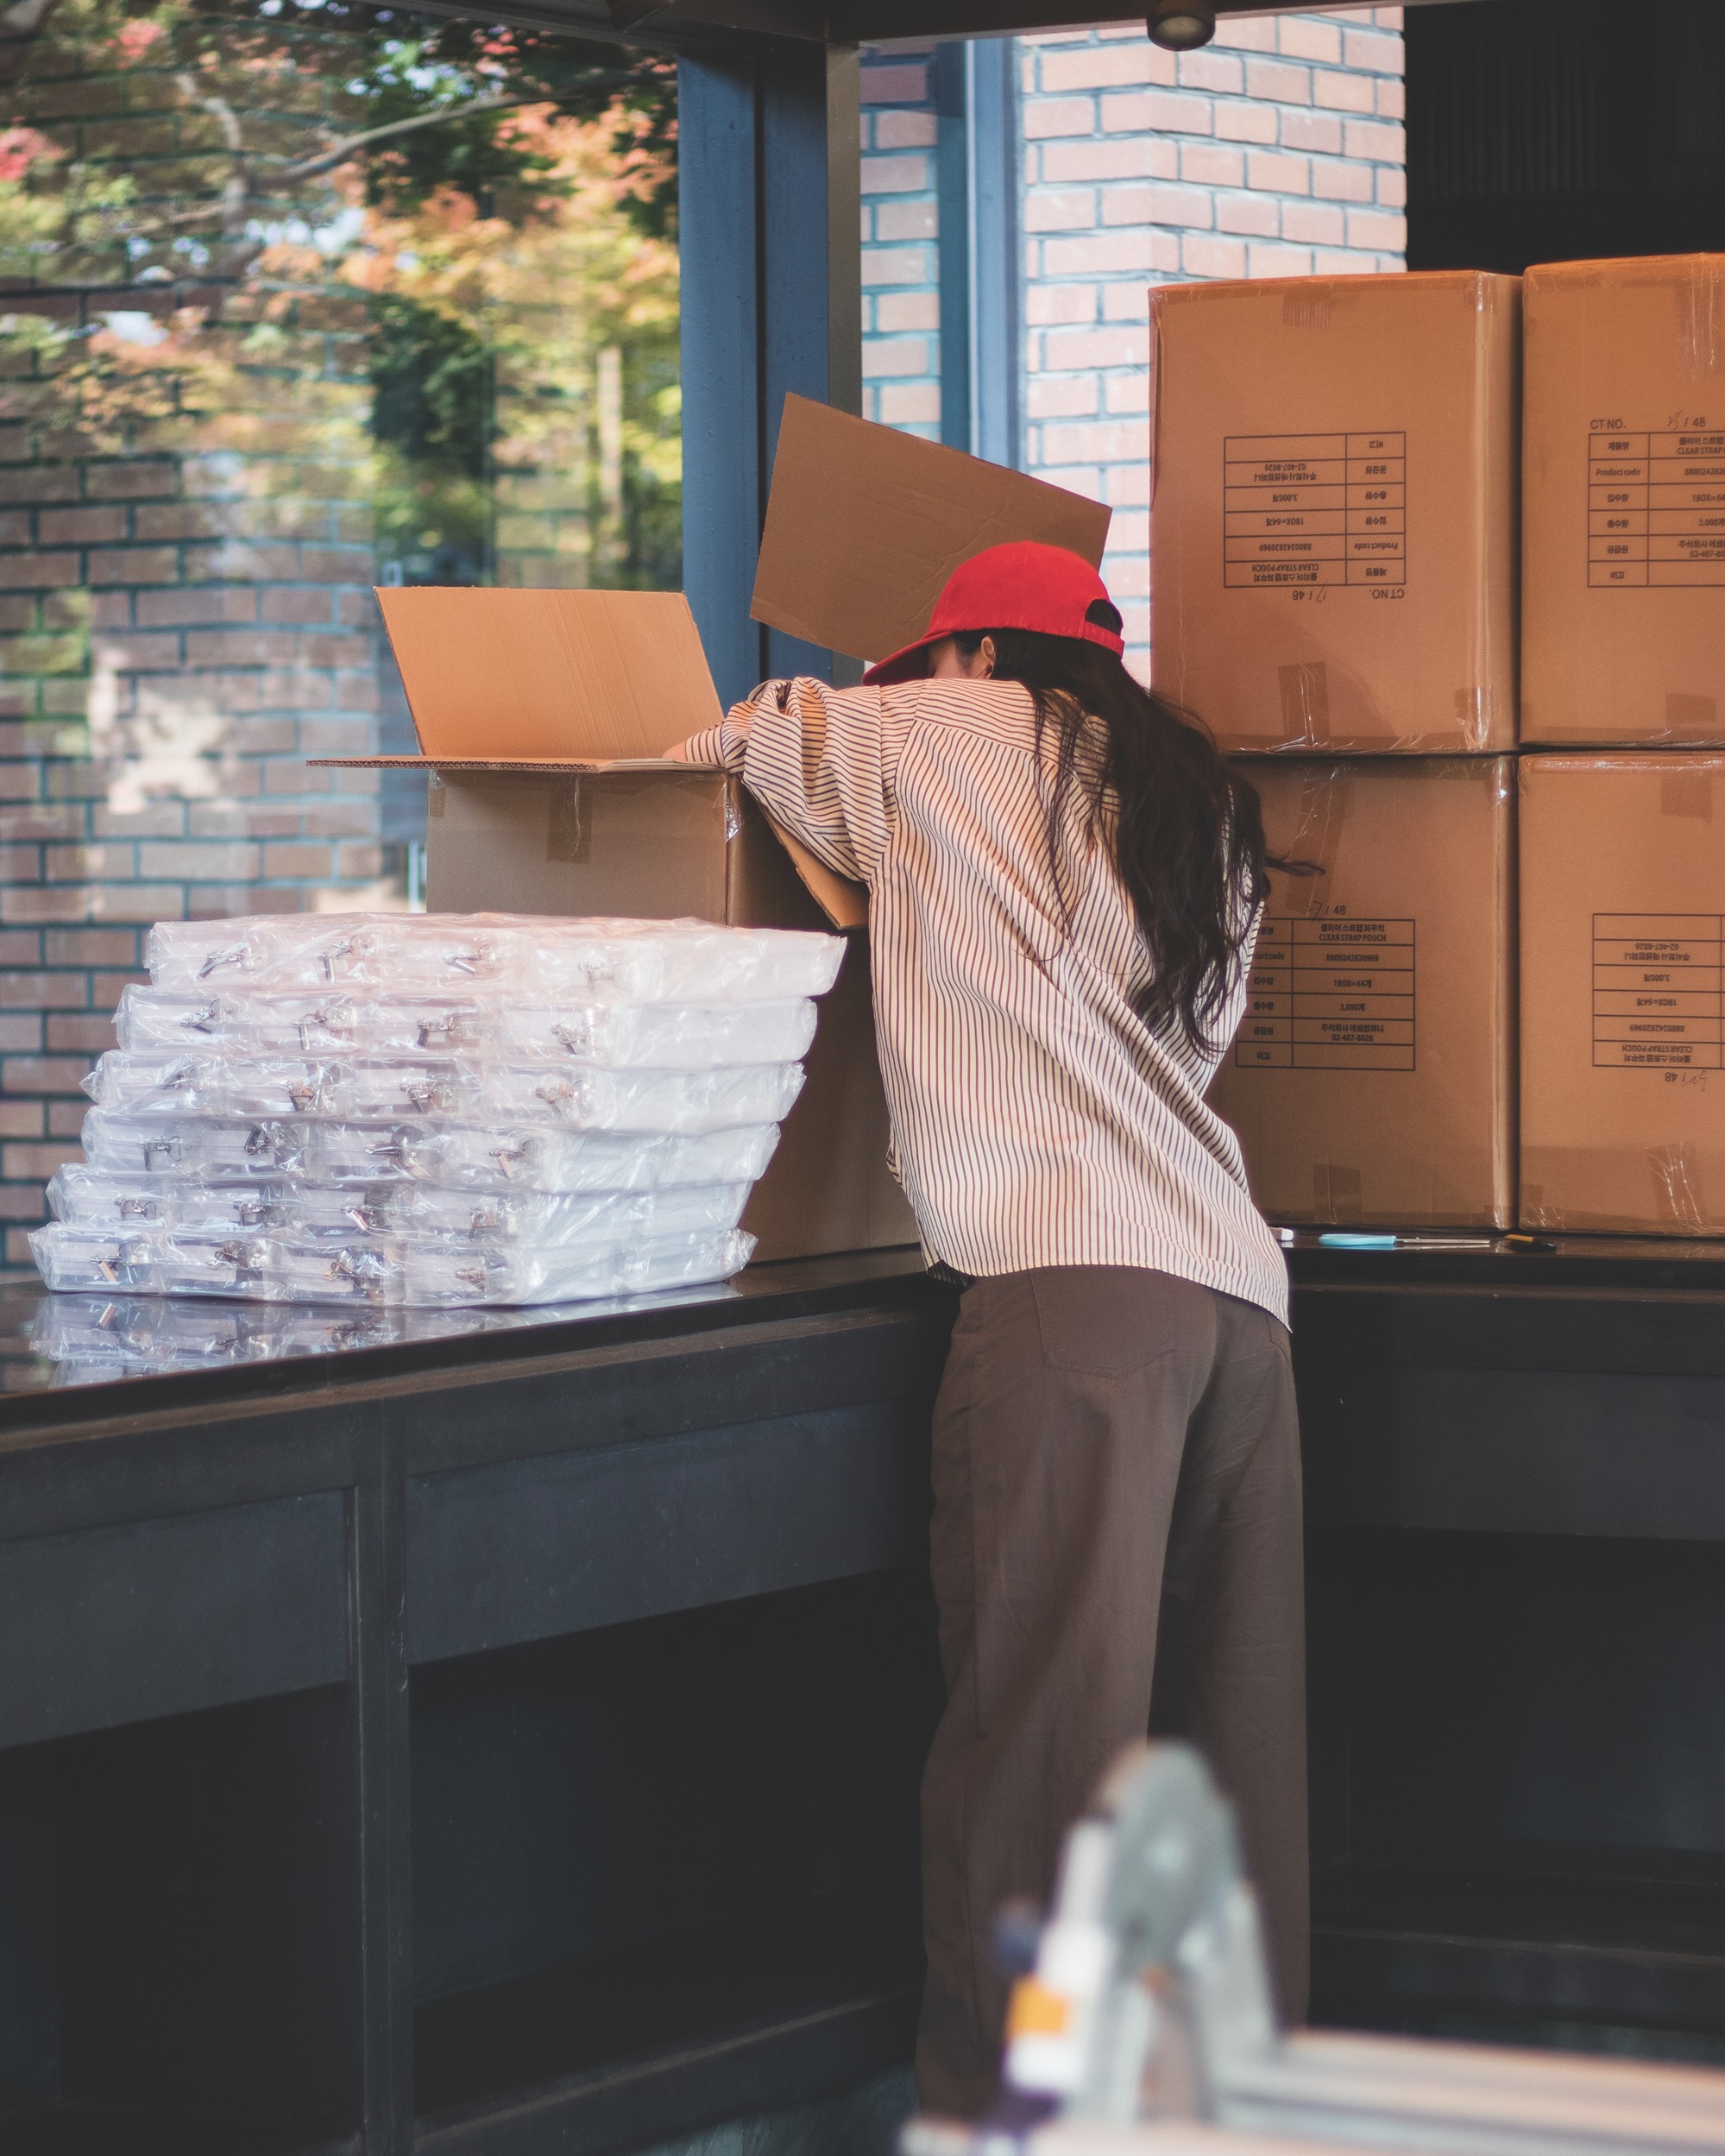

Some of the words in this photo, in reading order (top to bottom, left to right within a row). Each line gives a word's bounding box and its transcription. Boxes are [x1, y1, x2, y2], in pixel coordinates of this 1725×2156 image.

[1590, 419, 1606, 429] CT
[1608, 419, 1625, 429] NO.
[1693, 418, 1705, 427] 48
[1366, 466, 1387, 475] 공급원
[1608, 494, 1628, 502] 입수량
[1608, 545, 1628, 554] 공급원
[1366, 568, 1387, 577] 제품명
[1293, 590, 1305, 600] 48
[1369, 589, 1388, 599] NO.
[1389, 589, 1404, 599] CT
[1334, 906, 1345, 915] 48
[1644, 974, 1670, 982] 3,000개
[1340, 1003, 1365, 1012] 3,000개
[1630, 1024, 1684, 1032] 8800242820969
[1665, 1072, 1678, 1081] 48
